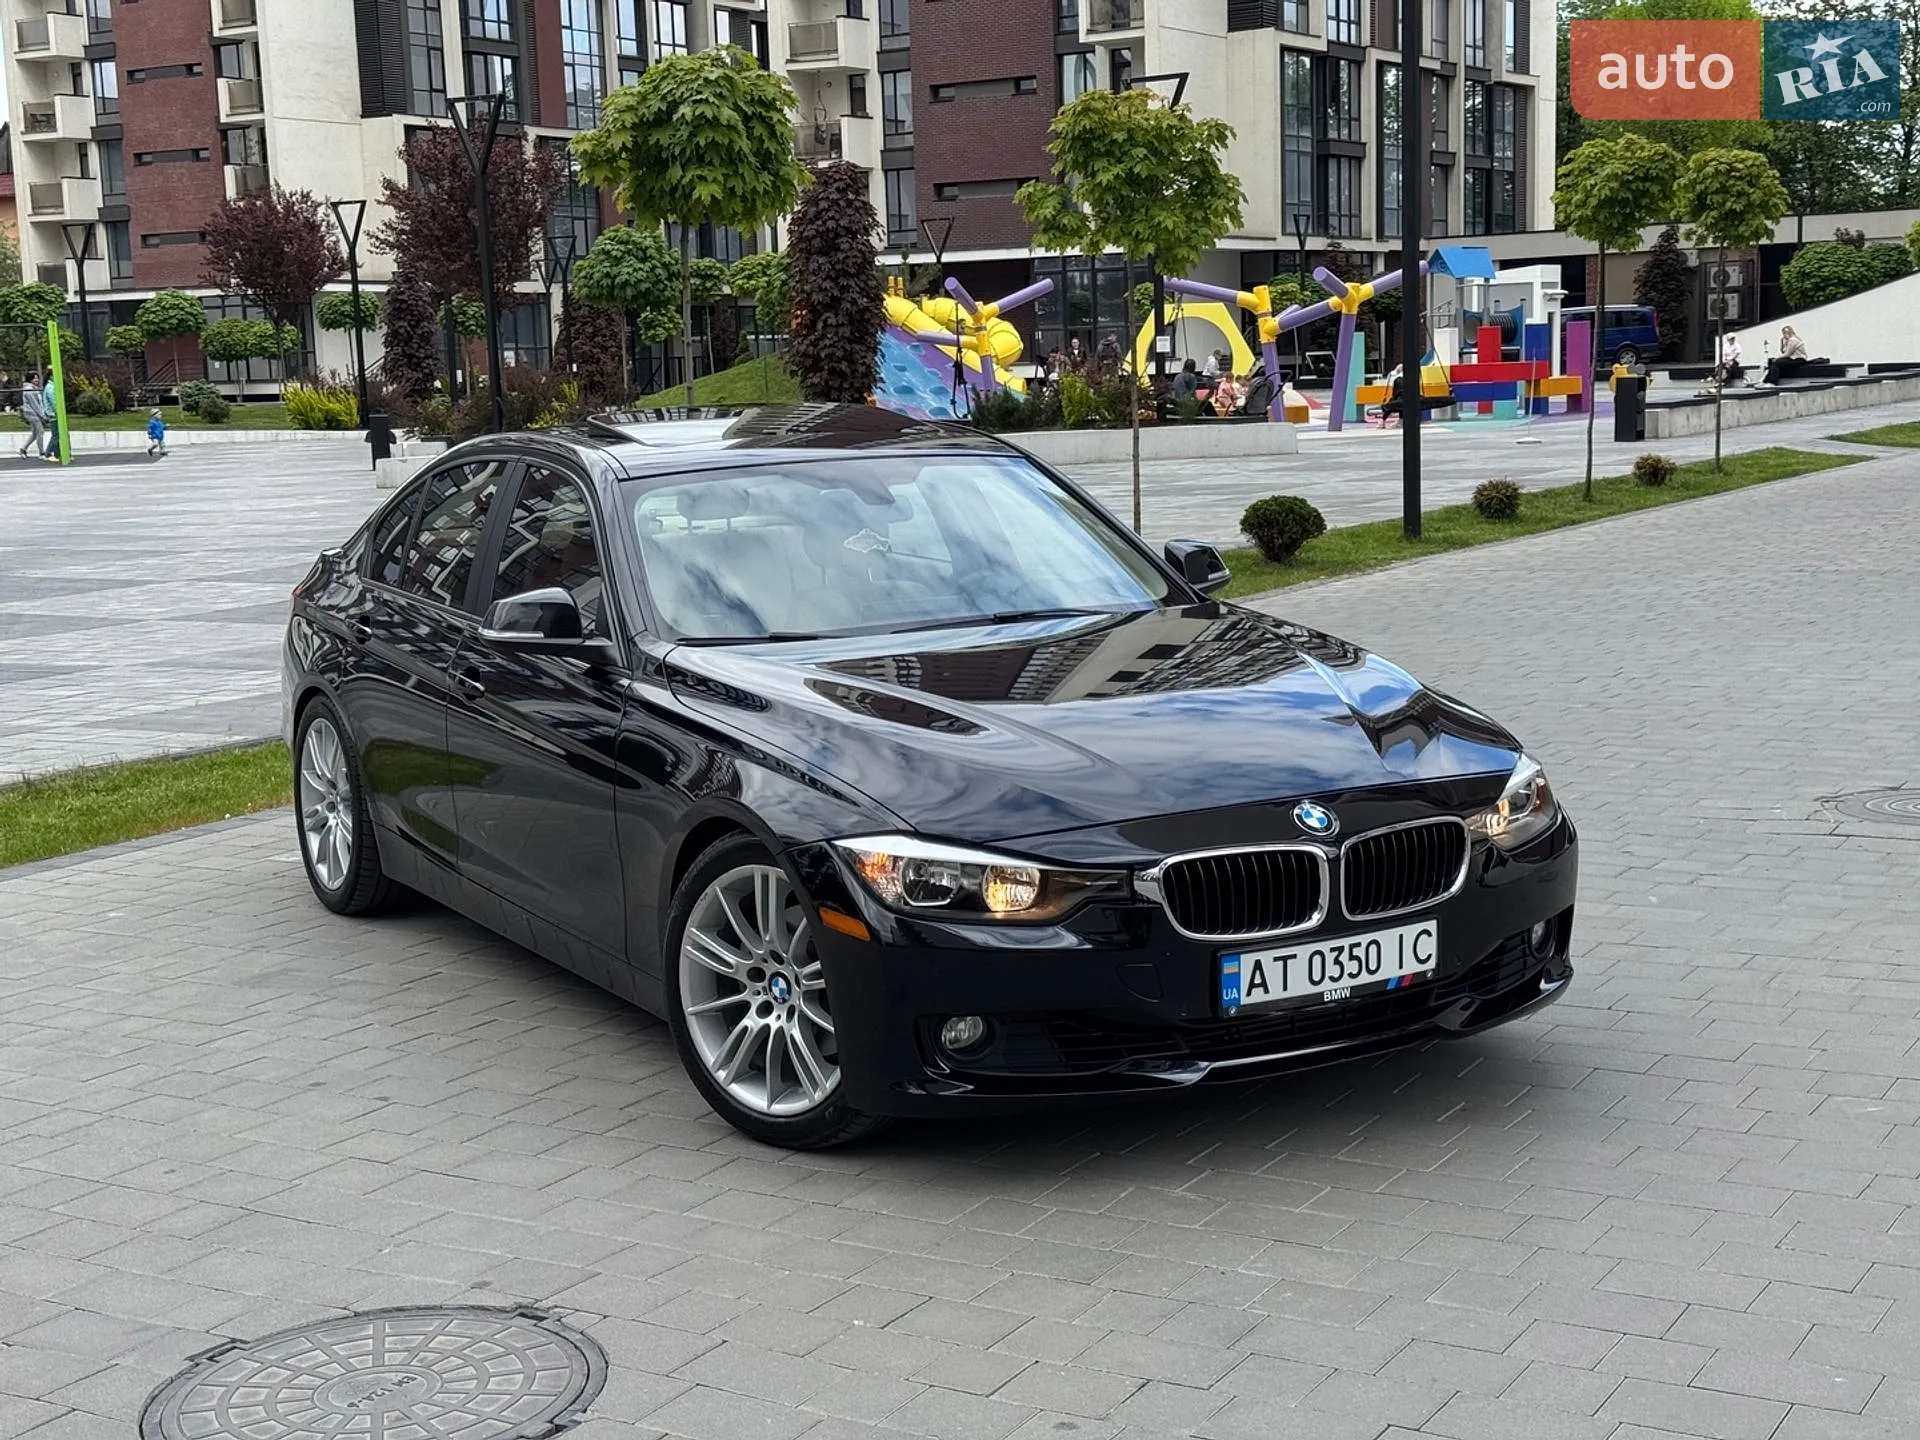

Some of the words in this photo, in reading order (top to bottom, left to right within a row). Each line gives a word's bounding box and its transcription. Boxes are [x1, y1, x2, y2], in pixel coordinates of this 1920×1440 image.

[1245, 953, 1297, 997] AT
[1307, 938, 1381, 987] 0350
[1398, 928, 1433, 970] IC
[1222, 988, 1239, 1000] UA
[1323, 987, 1351, 1002] BMW
